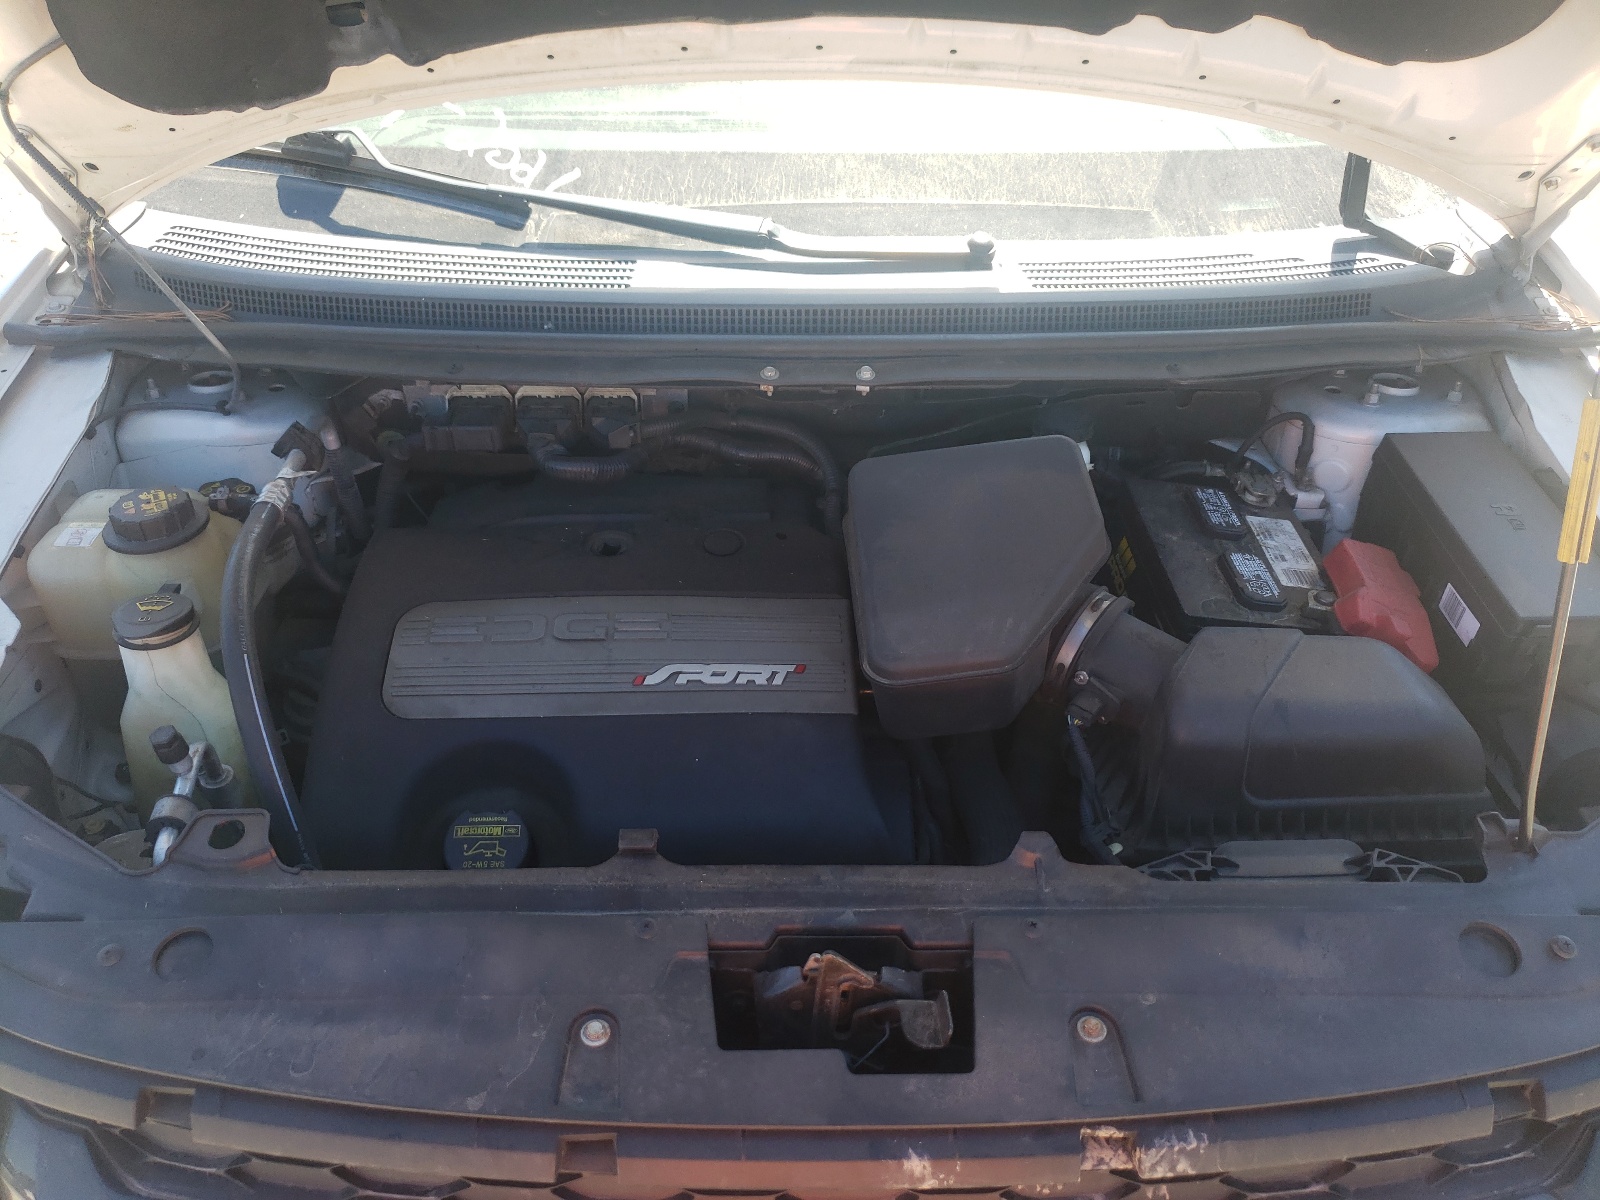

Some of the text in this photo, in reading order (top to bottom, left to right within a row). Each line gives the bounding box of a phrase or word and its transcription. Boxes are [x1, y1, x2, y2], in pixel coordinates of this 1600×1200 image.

[430, 612, 669, 643] EDGE
[642, 662, 798, 687] SPORT
[456, 826, 502, 836] Motorcraft
[463, 860, 504, 868] SAE 5W-20
